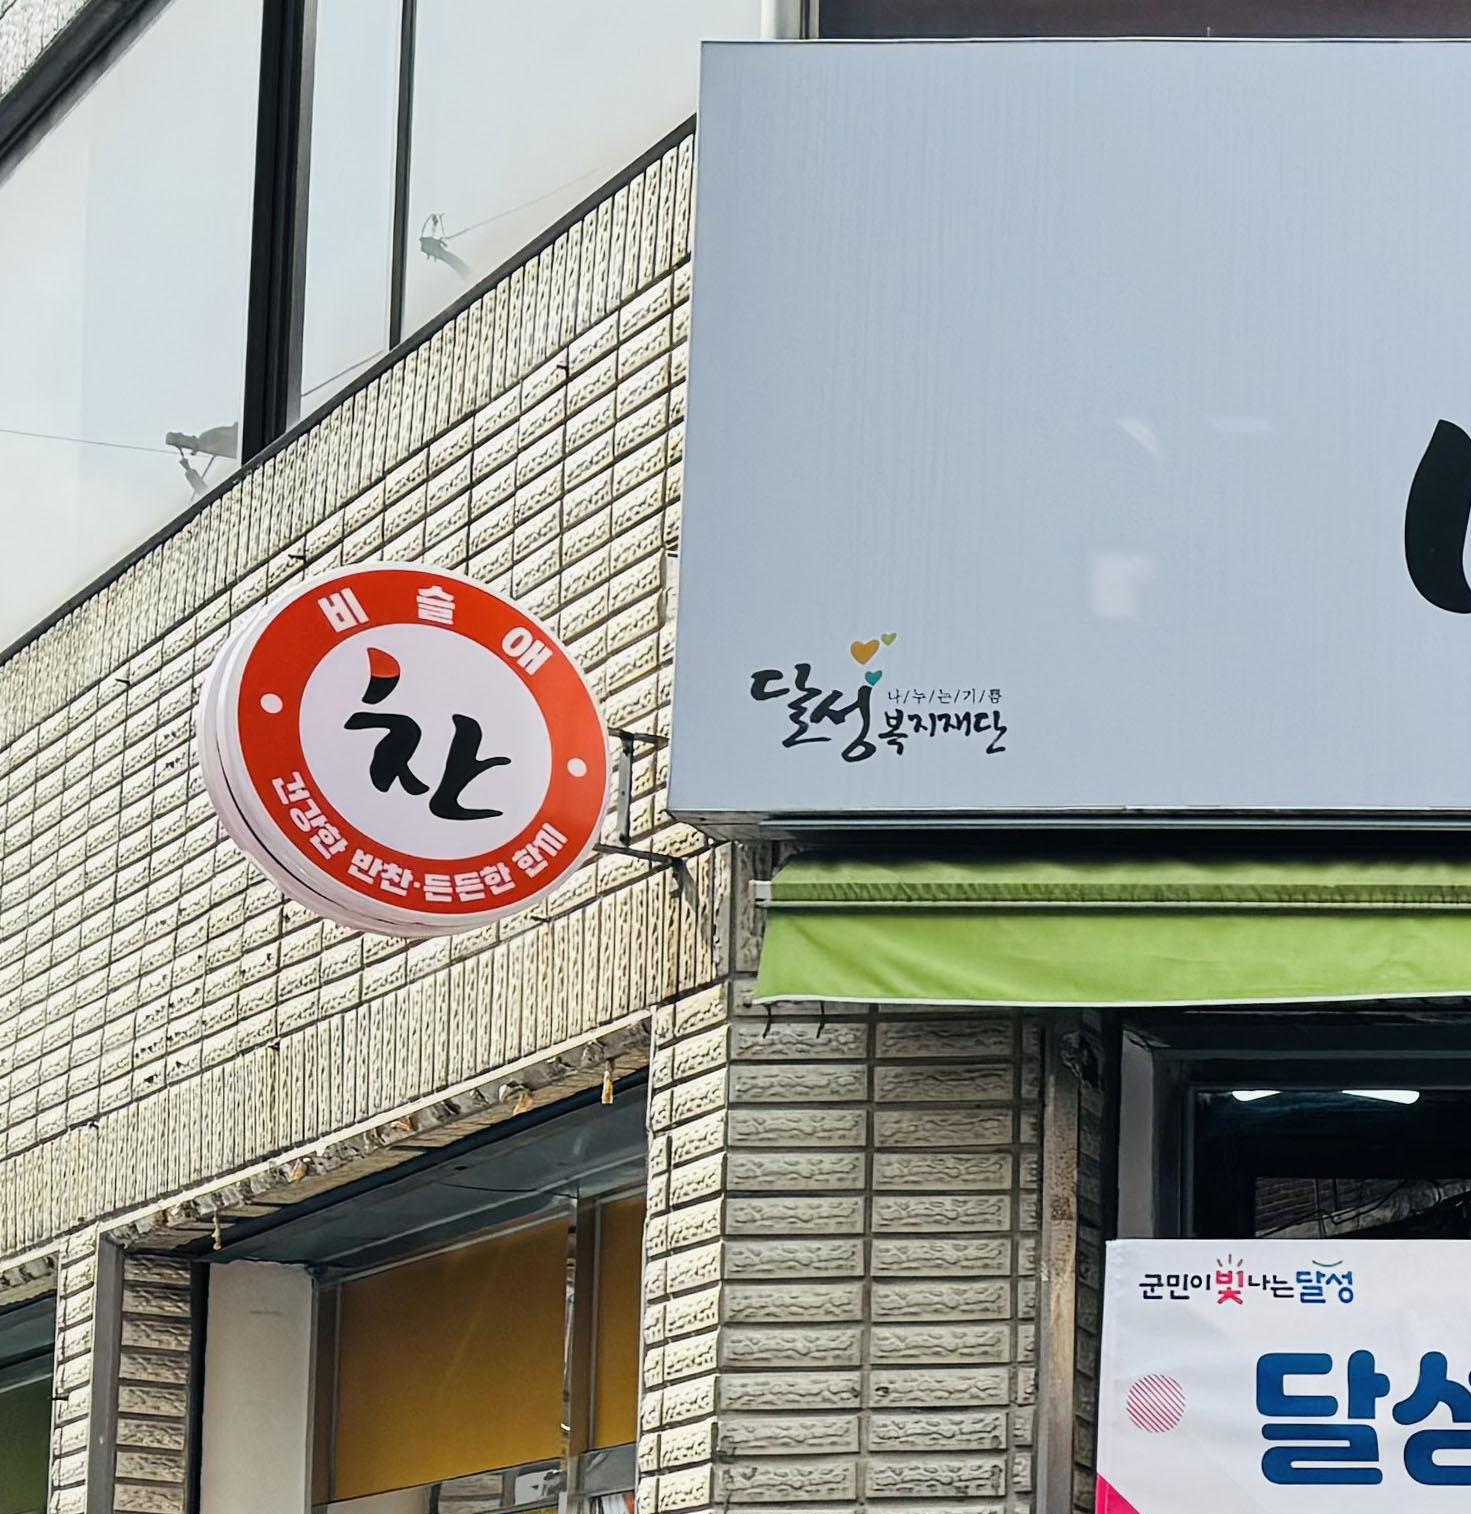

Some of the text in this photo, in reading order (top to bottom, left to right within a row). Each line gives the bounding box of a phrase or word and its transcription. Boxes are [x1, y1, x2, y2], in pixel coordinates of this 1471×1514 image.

[317, 584, 555, 677] 비슬애
[344, 646, 512, 821] 찬
[750, 663, 1008, 763] 달성 복지재단
[272, 771, 350, 861] 건강한
[511, 822, 569, 879] 한끼
